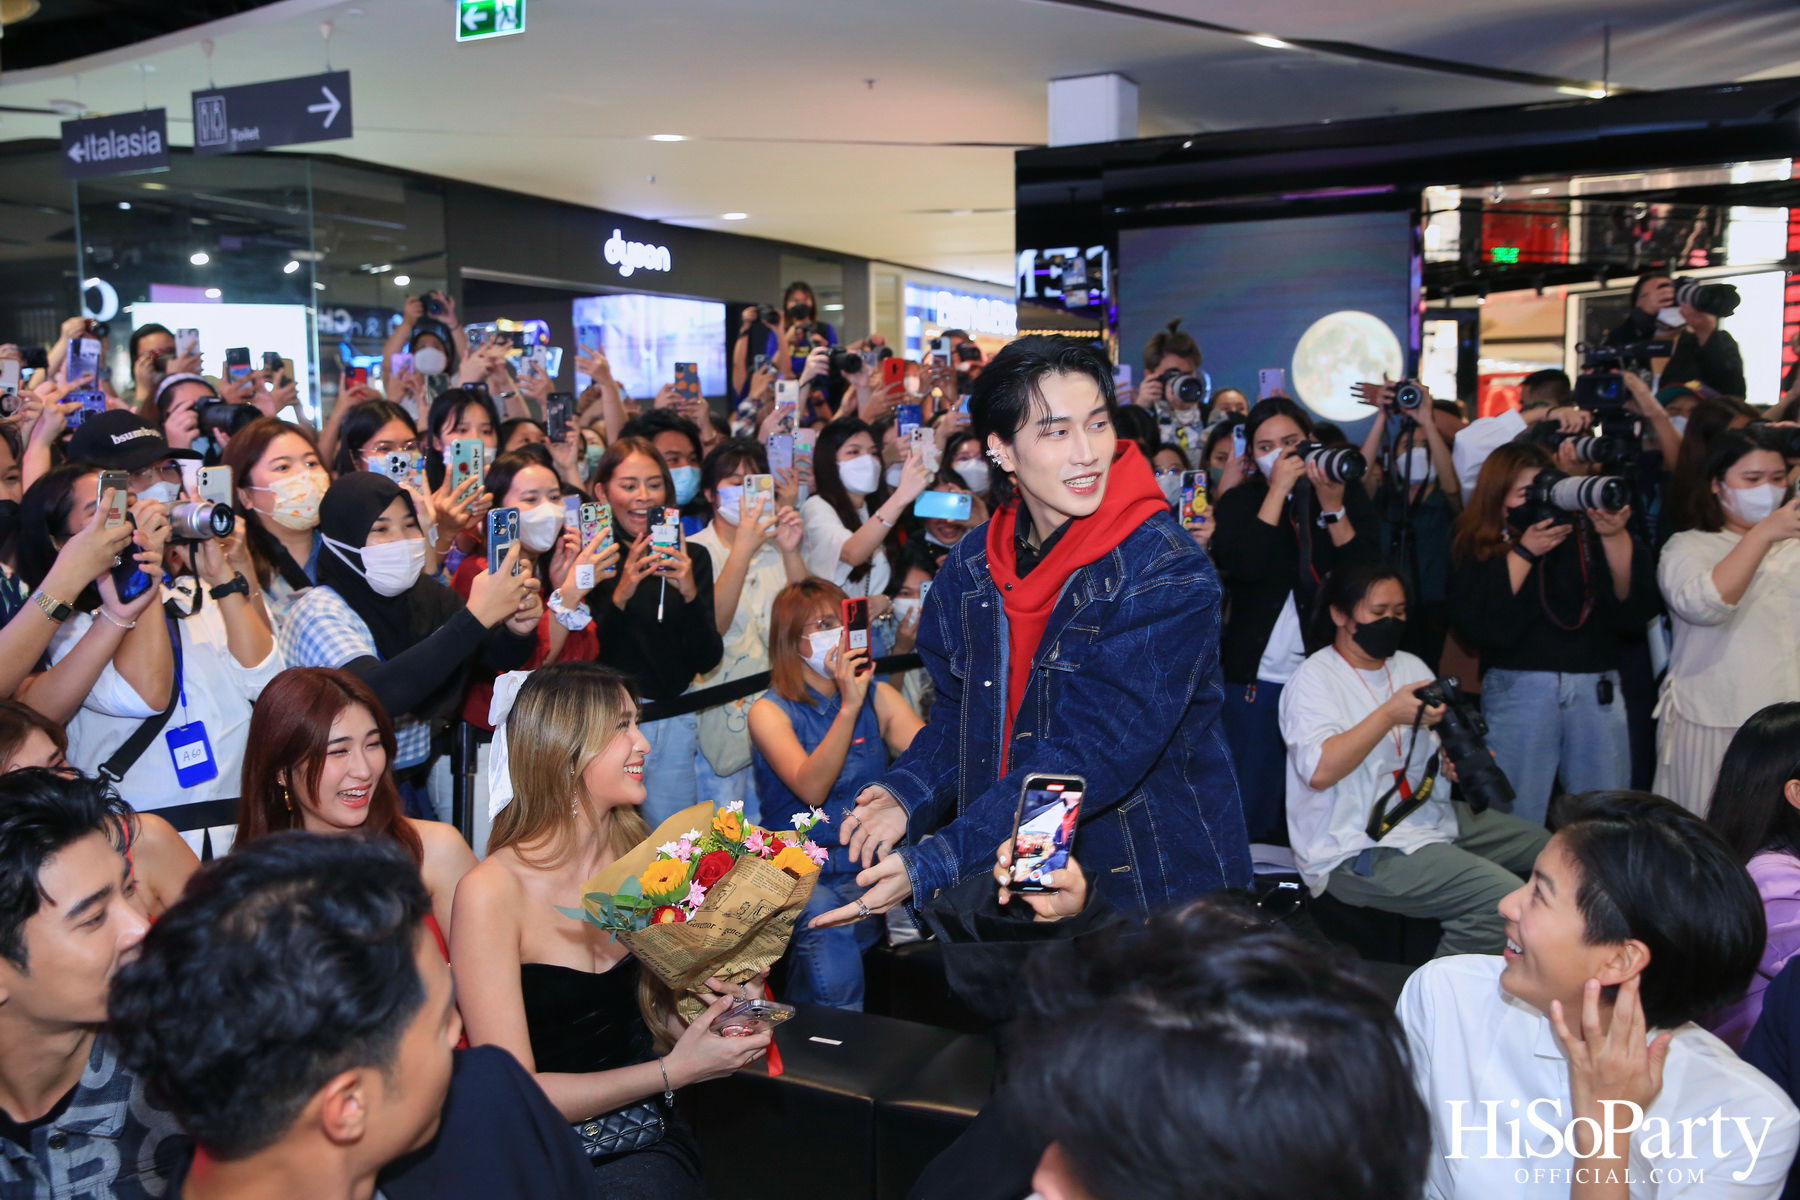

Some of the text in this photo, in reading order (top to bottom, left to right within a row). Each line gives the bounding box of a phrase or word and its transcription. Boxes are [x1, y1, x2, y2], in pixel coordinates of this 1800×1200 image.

[84, 126, 162, 162] Italasia
[231, 127, 260, 142] Toilet
[604, 228, 671, 277] dyson
